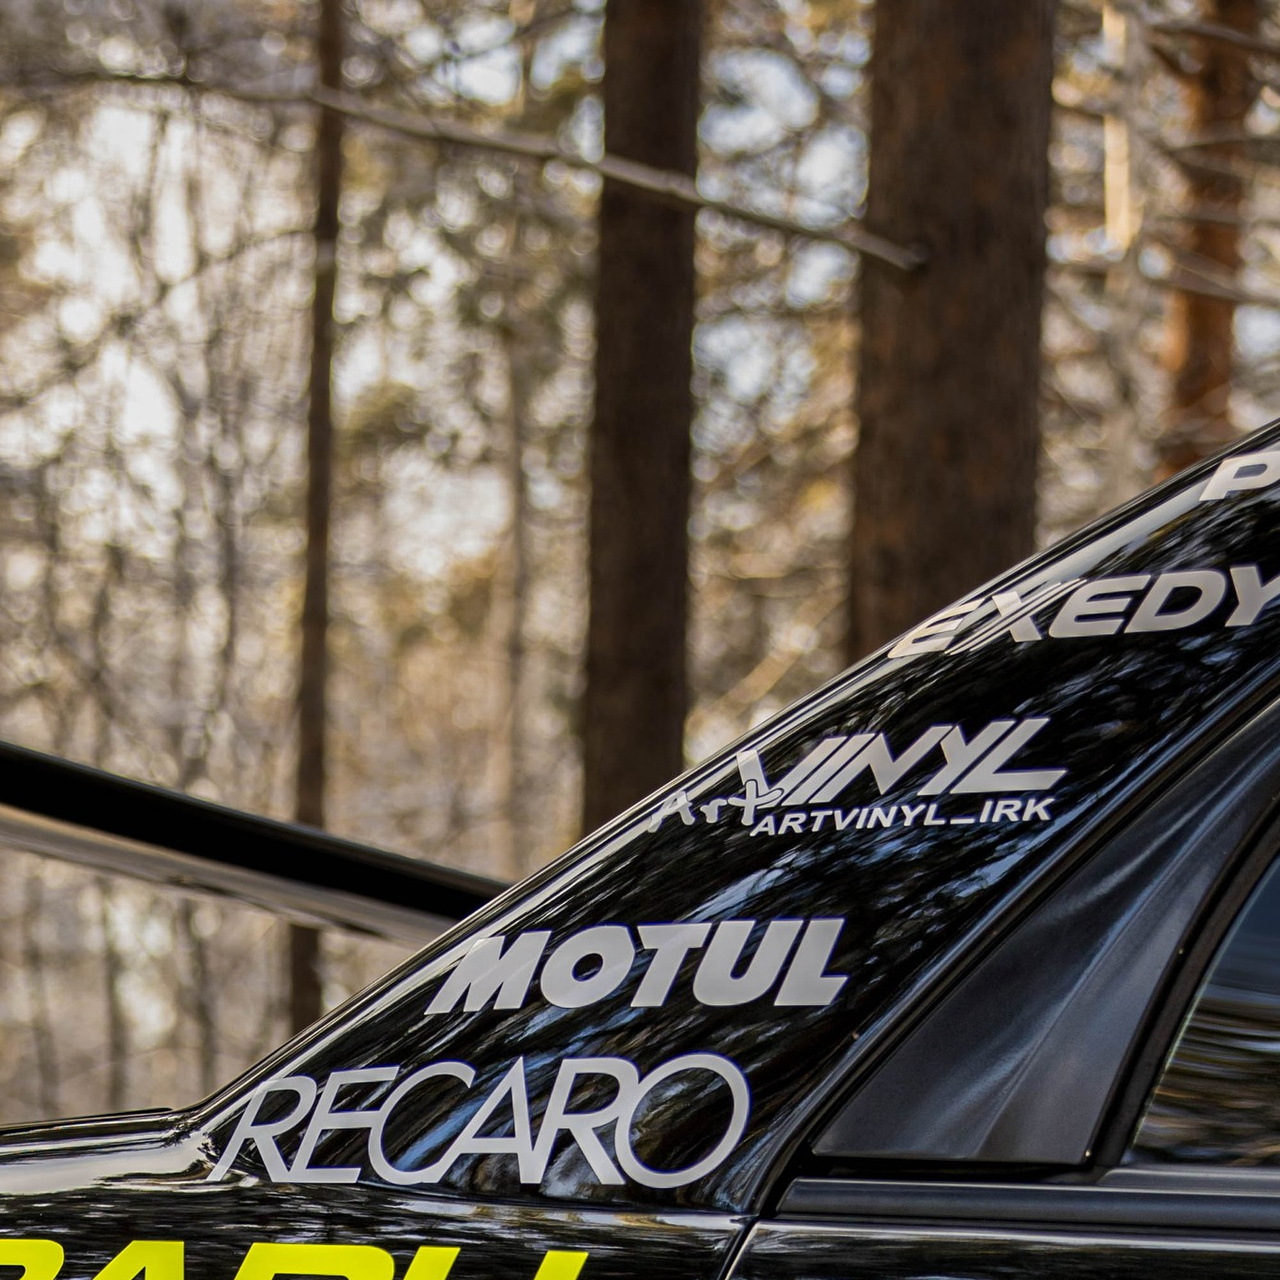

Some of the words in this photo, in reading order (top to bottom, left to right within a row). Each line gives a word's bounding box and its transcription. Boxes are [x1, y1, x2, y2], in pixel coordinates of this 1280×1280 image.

[888, 566, 1280, 659] EXEDY
[750, 797, 1055, 837] ARTVINYL_IRK
[424, 918, 849, 1015] MOTUL
[207, 1052, 751, 1189] RECARO
